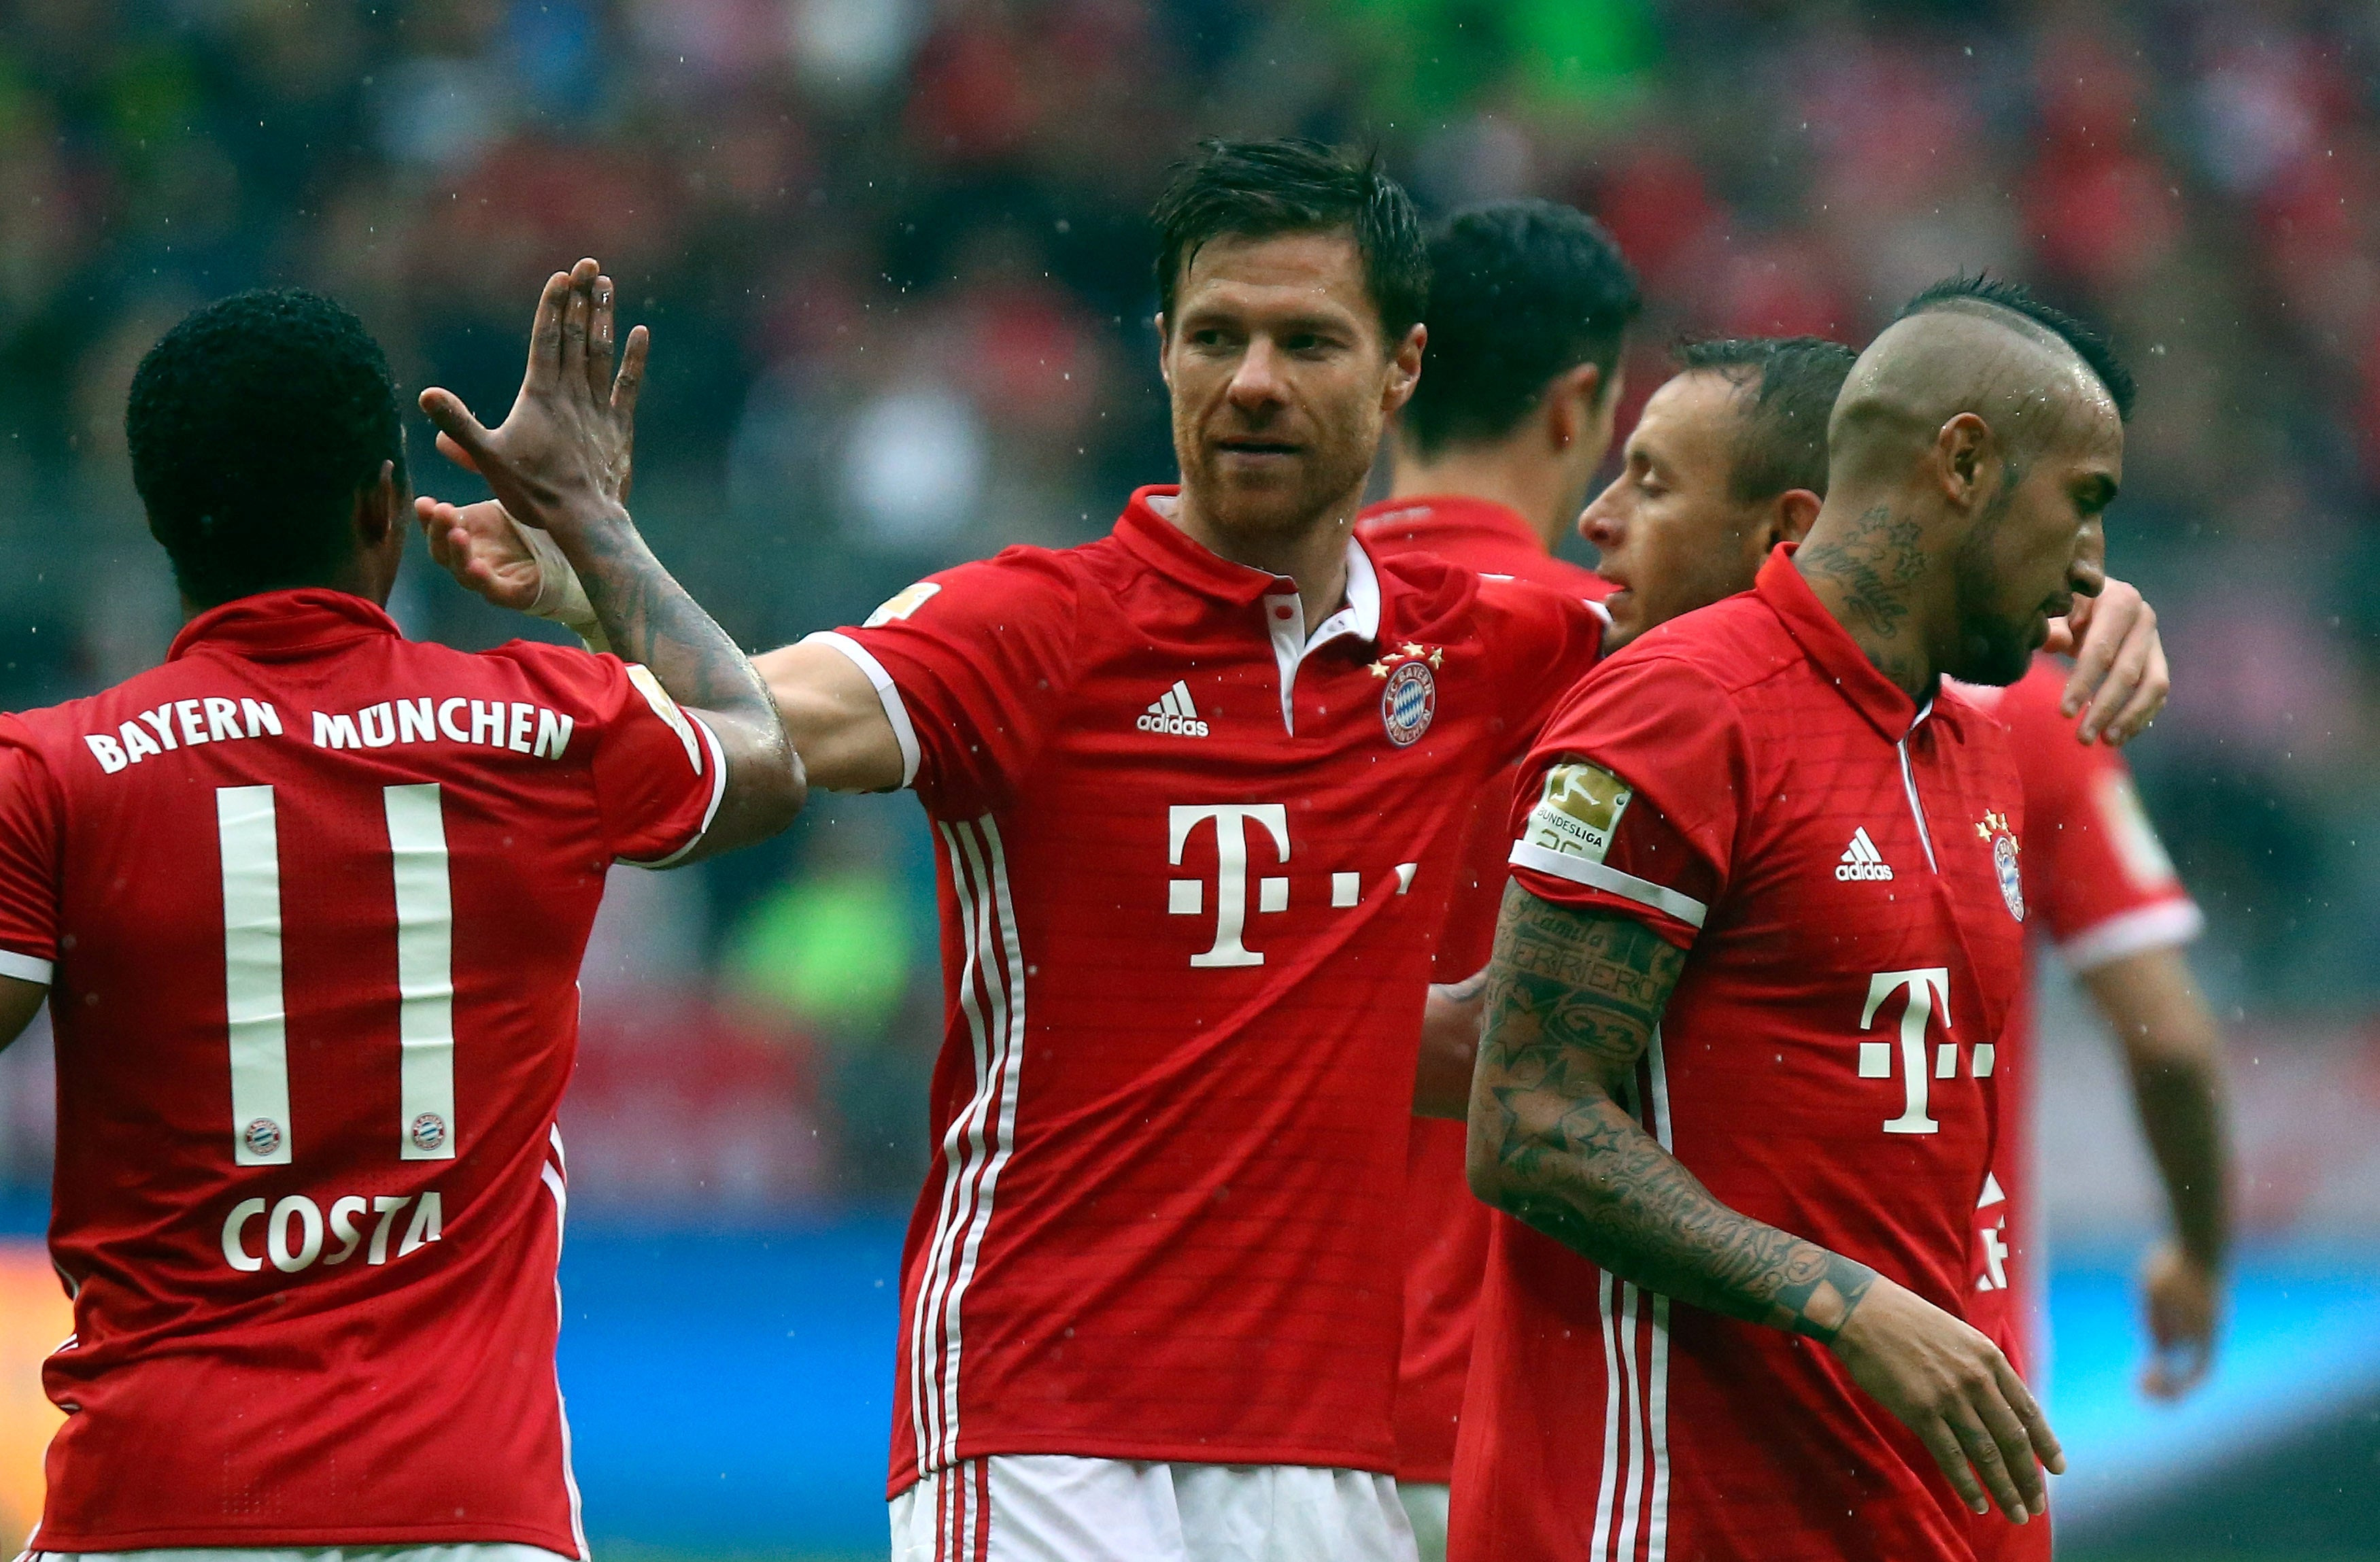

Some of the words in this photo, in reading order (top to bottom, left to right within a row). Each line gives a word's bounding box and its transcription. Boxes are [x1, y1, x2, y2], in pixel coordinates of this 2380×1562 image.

[84, 697, 283, 775] BAYERN
[312, 696, 575, 762] MÜNCHEN
[1136, 713, 1209, 737] adidas
[1537, 807, 1603, 848] BUNDESLIGA
[1834, 861, 1894, 881] adidas
[216, 782, 456, 1166] 11
[221, 1191, 443, 1273] COSTA
